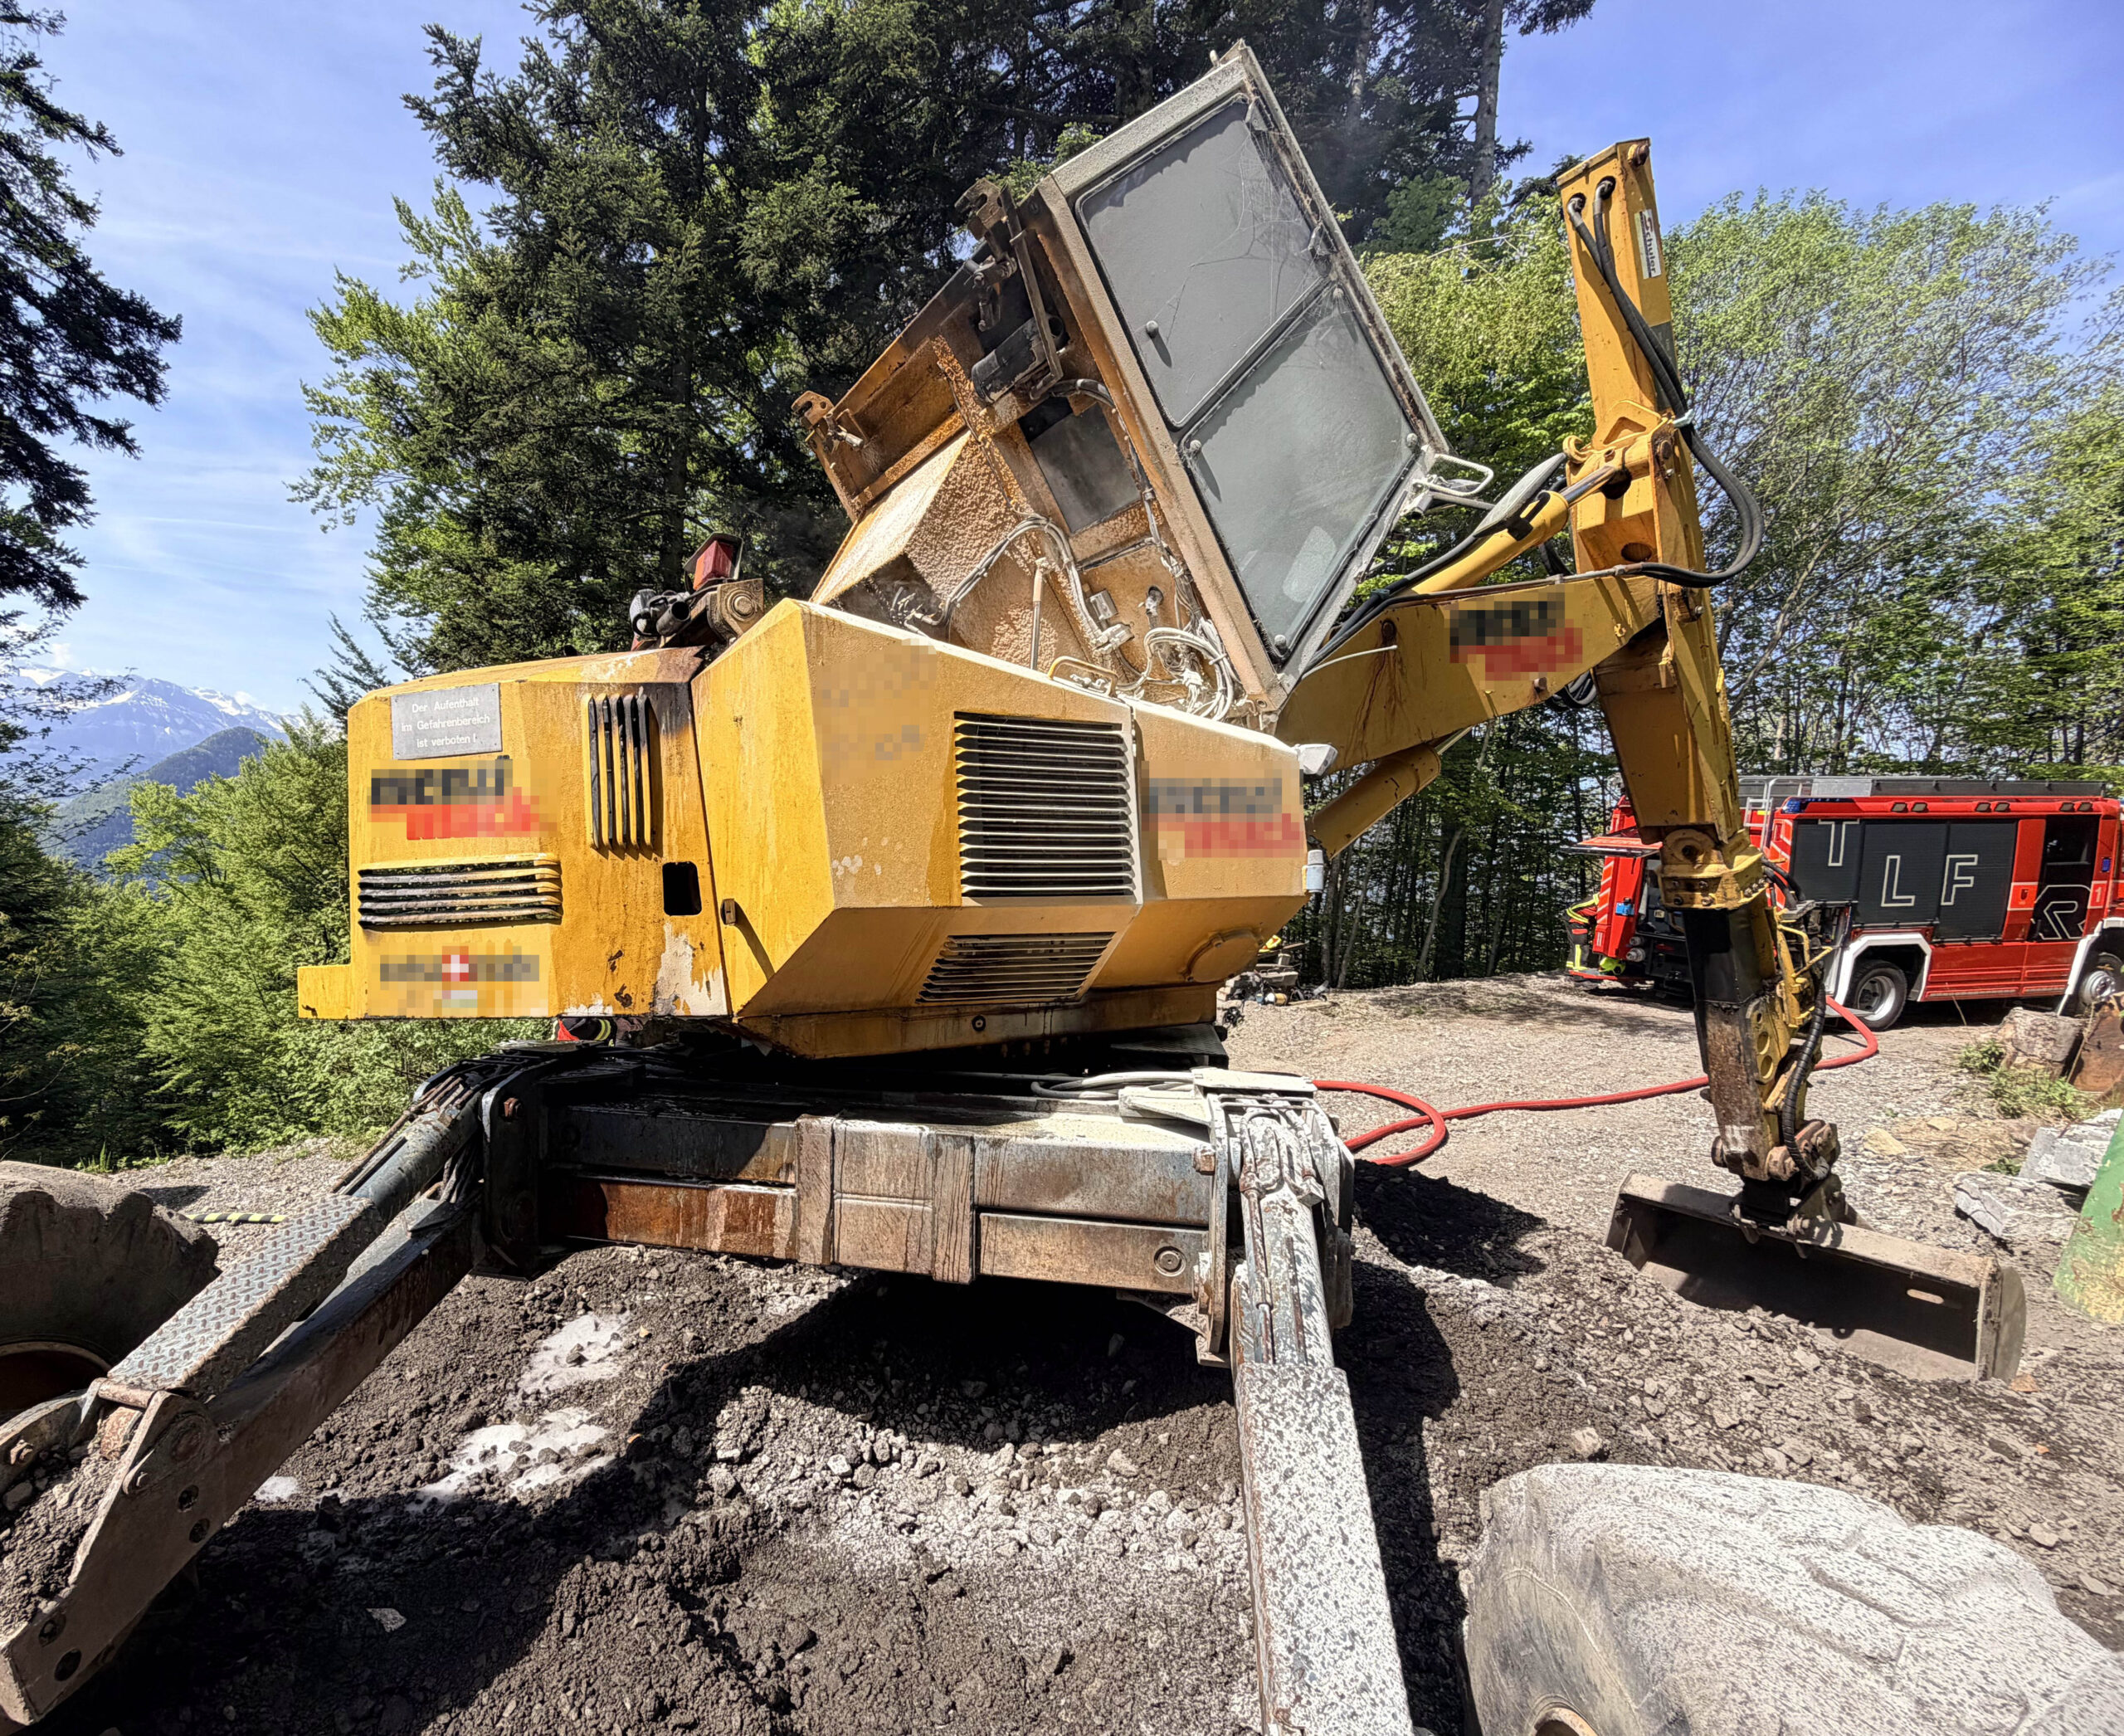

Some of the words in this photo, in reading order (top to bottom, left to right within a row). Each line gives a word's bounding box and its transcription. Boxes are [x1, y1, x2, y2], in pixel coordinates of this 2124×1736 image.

[1643, 212, 1656, 273] Schuler
[412, 704, 428, 713] Der
[434, 697, 480, 711] Aufenthalt
[402, 723, 412, 731] im
[417, 714, 490, 730] Gefahrenbereich
[417, 738, 428, 748] ist
[2095, 886, 2102, 903] 1
